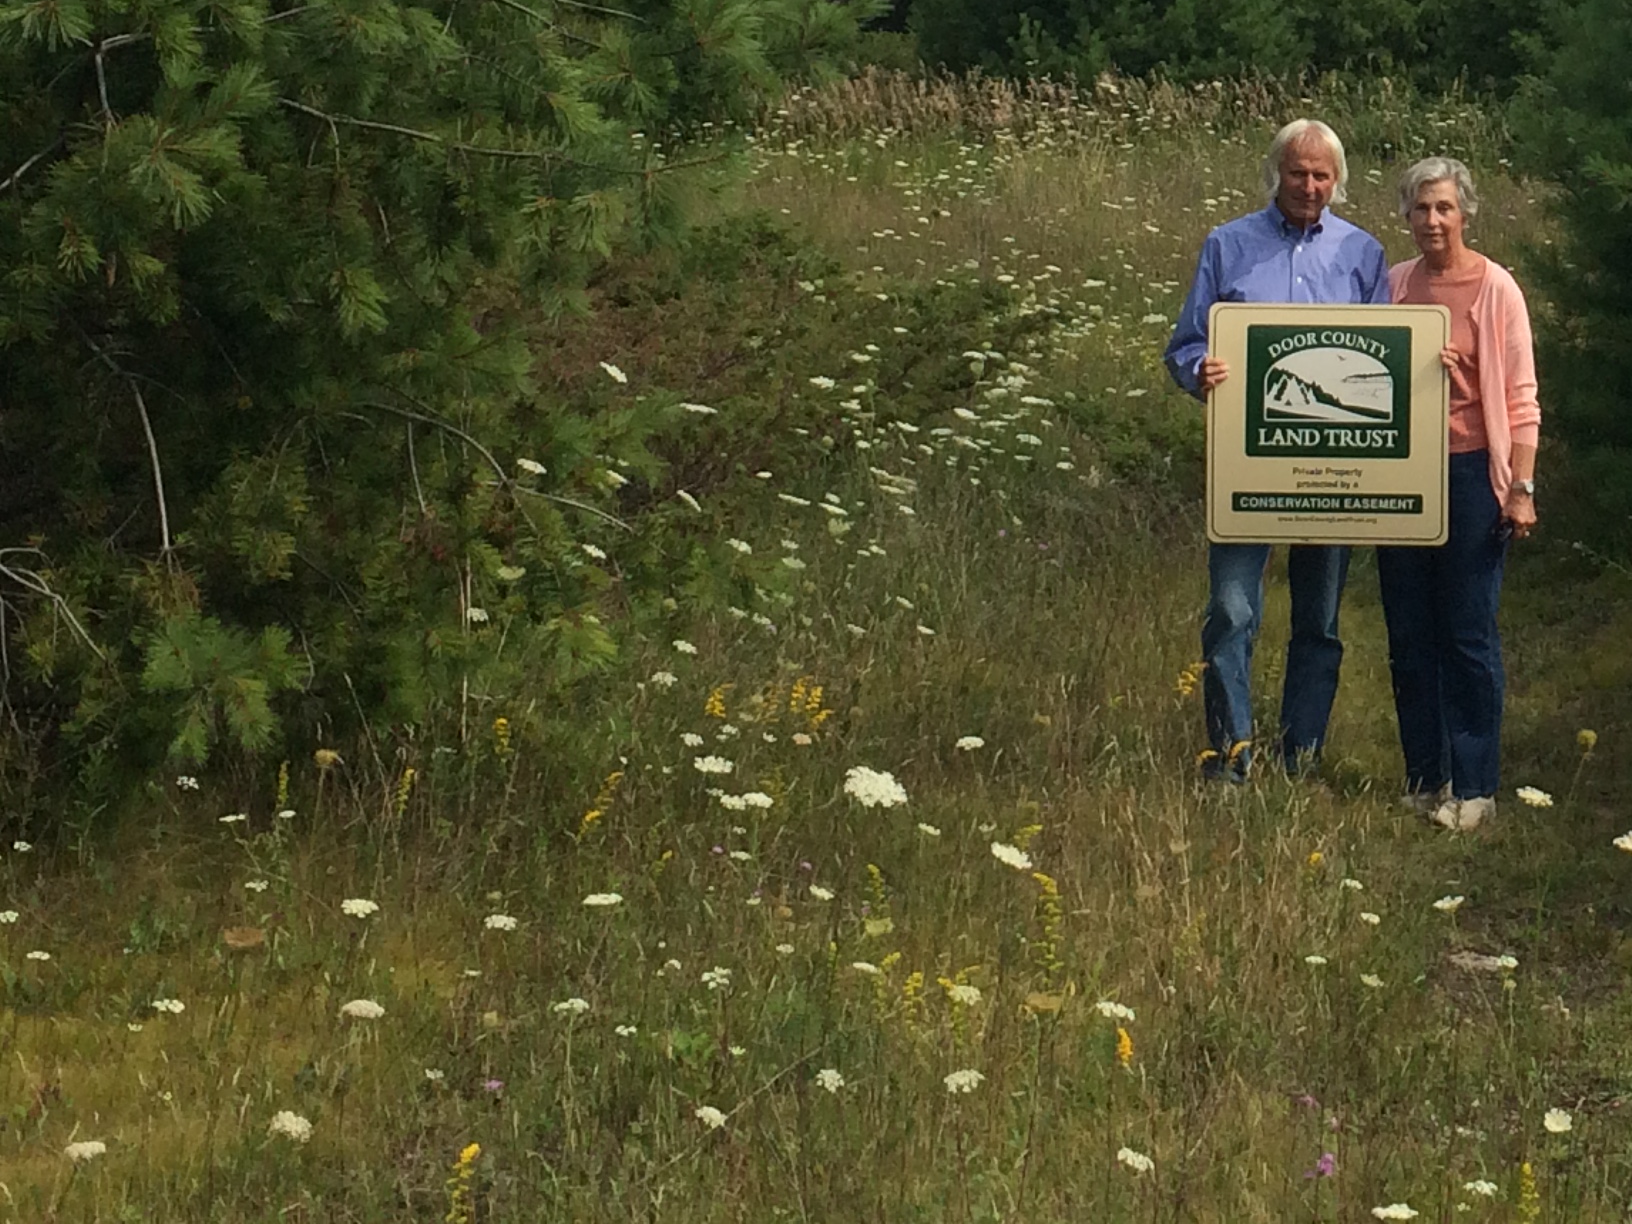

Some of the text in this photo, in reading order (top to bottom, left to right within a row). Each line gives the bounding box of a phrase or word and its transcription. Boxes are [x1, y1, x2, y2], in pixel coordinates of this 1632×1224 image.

[1267, 331, 1391, 359] DOOR COUNTY
[1258, 428, 1399, 448] LAND TRUST
[1292, 466, 1363, 478] Private Property
[1296, 480, 1338, 489] protected
[1340, 480, 1351, 489] by
[1239, 496, 1415, 510] CONSERVATION EASEMENT
